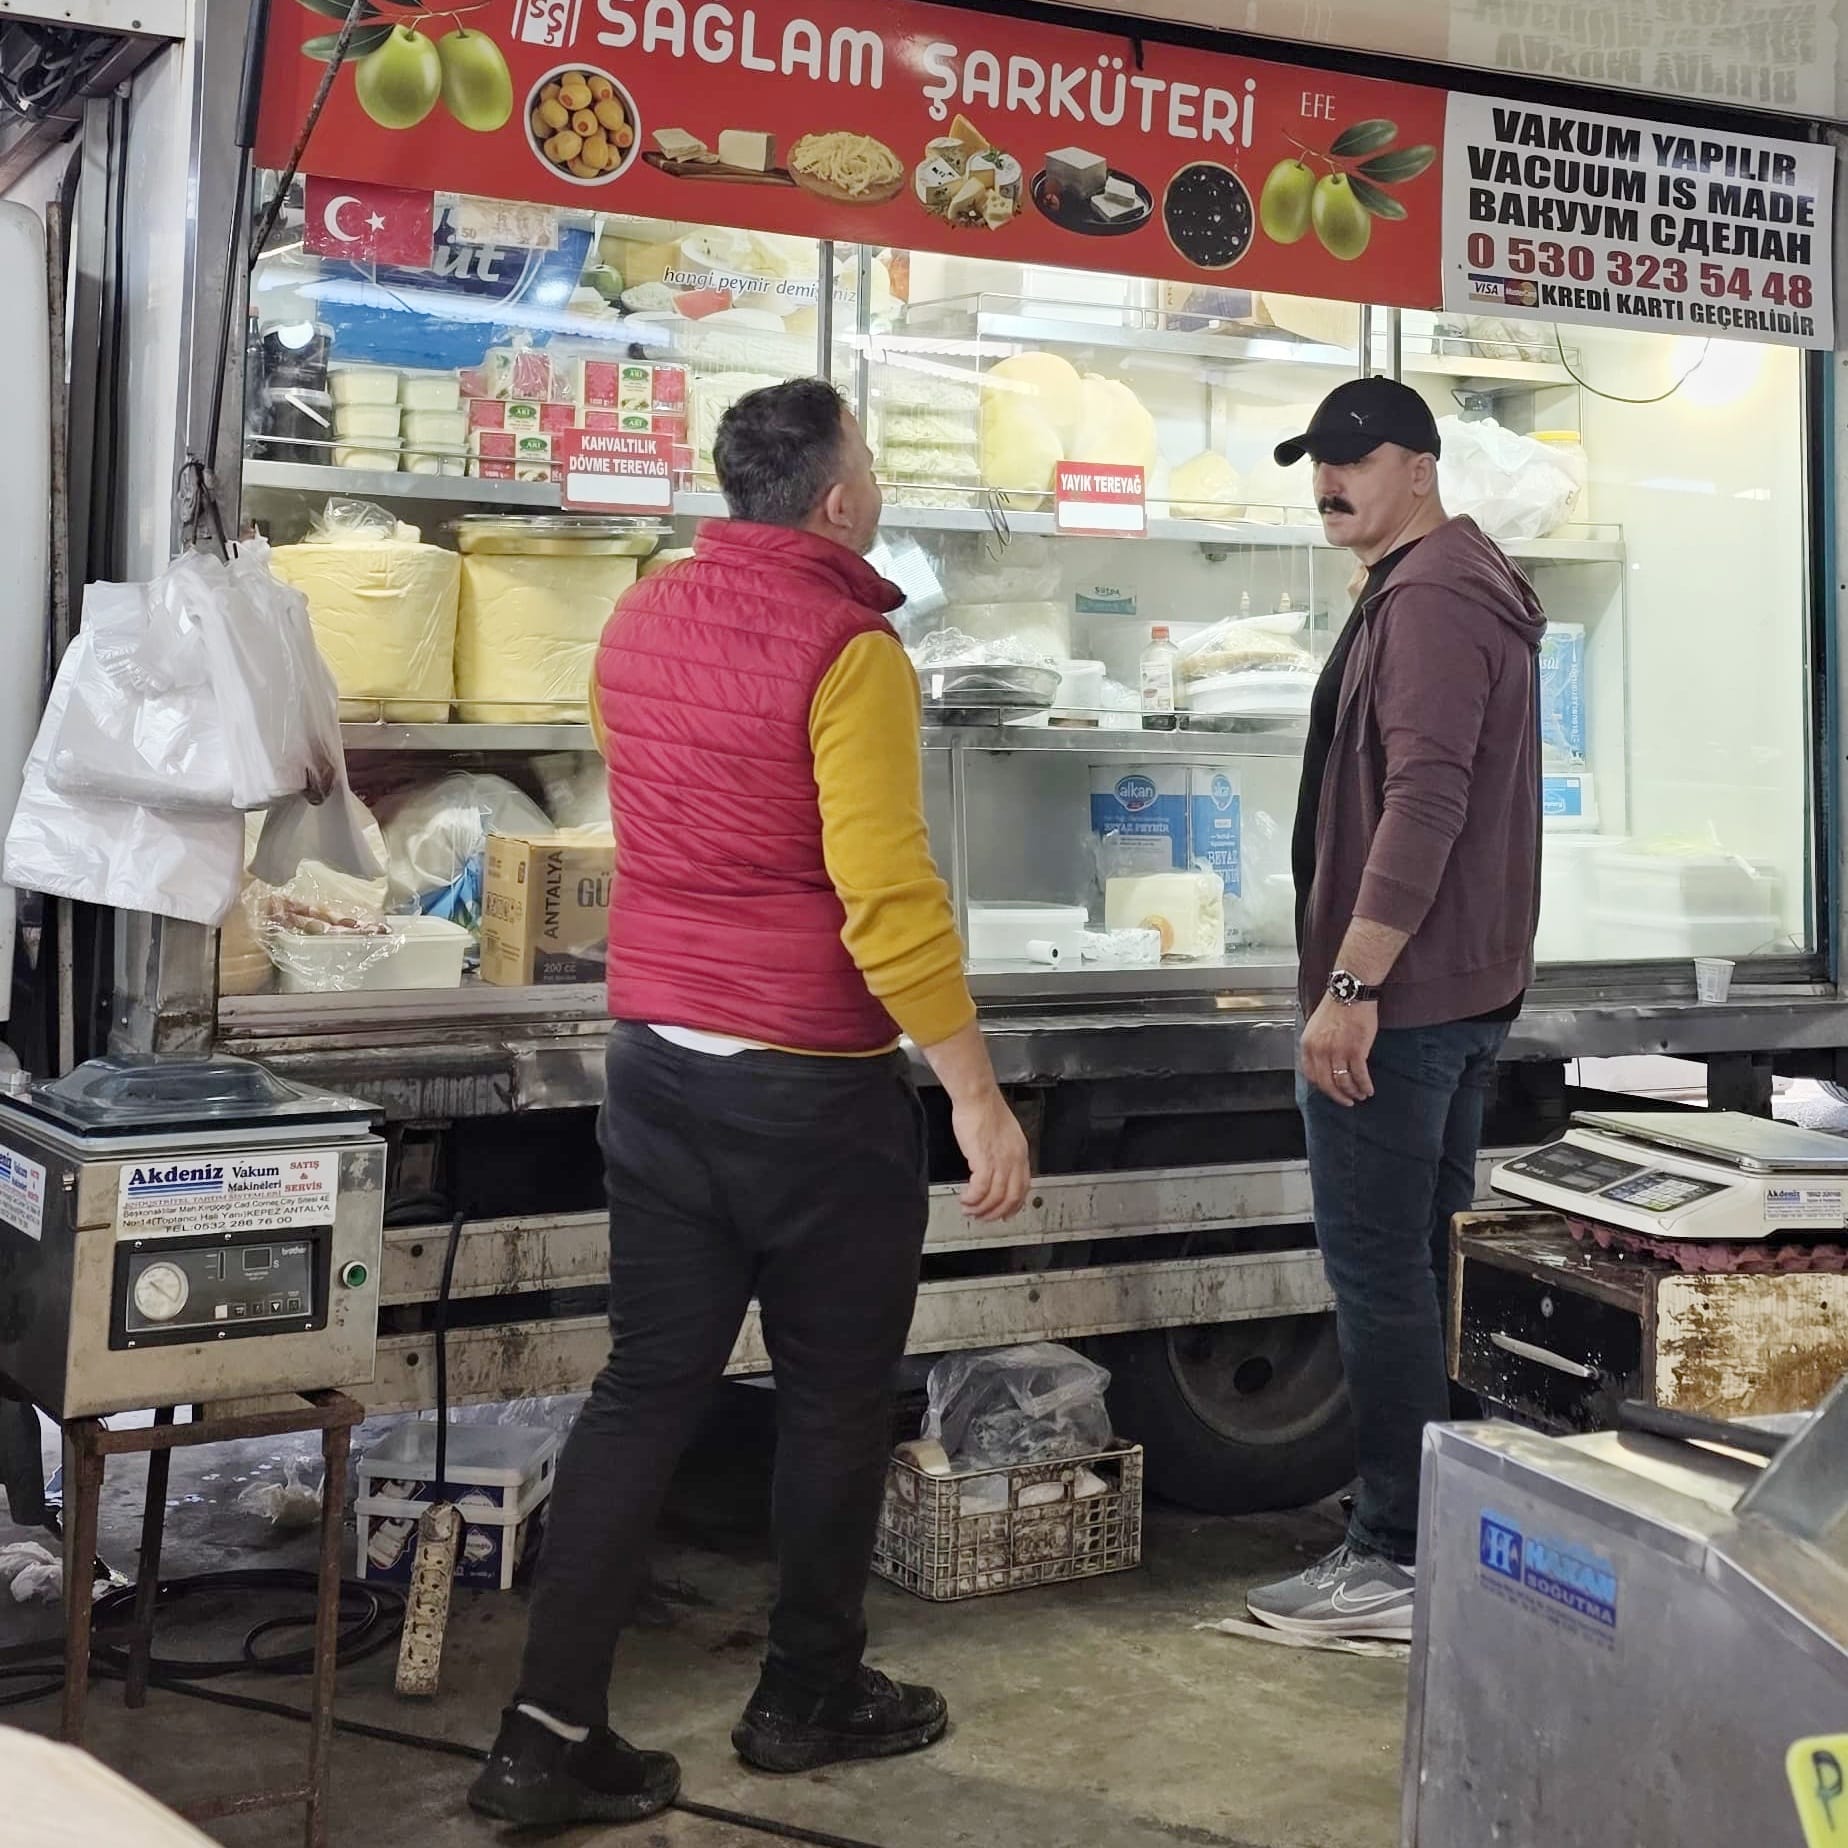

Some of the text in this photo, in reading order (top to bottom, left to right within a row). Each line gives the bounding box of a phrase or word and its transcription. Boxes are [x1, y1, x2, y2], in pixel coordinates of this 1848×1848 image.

[922, 42, 1256, 148] ŞARKÜTERİ
[1300, 91, 1337, 121] EFE
[1492, 107, 1797, 187] VAKUM YAPILIR
[1467, 145, 1815, 228] VACUUM IS MADE
[1469, 187, 1812, 265] ВАКУУМ СДЕЛАН
[664, 267, 713, 290] hangi
[718, 275, 770, 295] peynir
[1467, 232, 1812, 308] 0 530 323 54 48
[1475, 282, 1498, 295] VISA
[1542, 284, 1815, 337] KREDİ KARTI GEÇERLİDİR
[581, 435, 657, 455] KAHVALTILIK
[569, 454, 668, 476] DÖVME TEREYAĞI
[1061, 473, 1142, 495] YAYIK TEREYAĞ
[1119, 782, 1153, 798] alkan
[544, 851, 562, 939] ANTALYA
[128, 1160, 320, 1186] Akdeniz Vakum SATIŞ
[227, 1179, 322, 1193] Makineleri SERVİS
[277, 1216, 292, 1224] 00
[284, 1204, 329, 1214] ANTALYA
